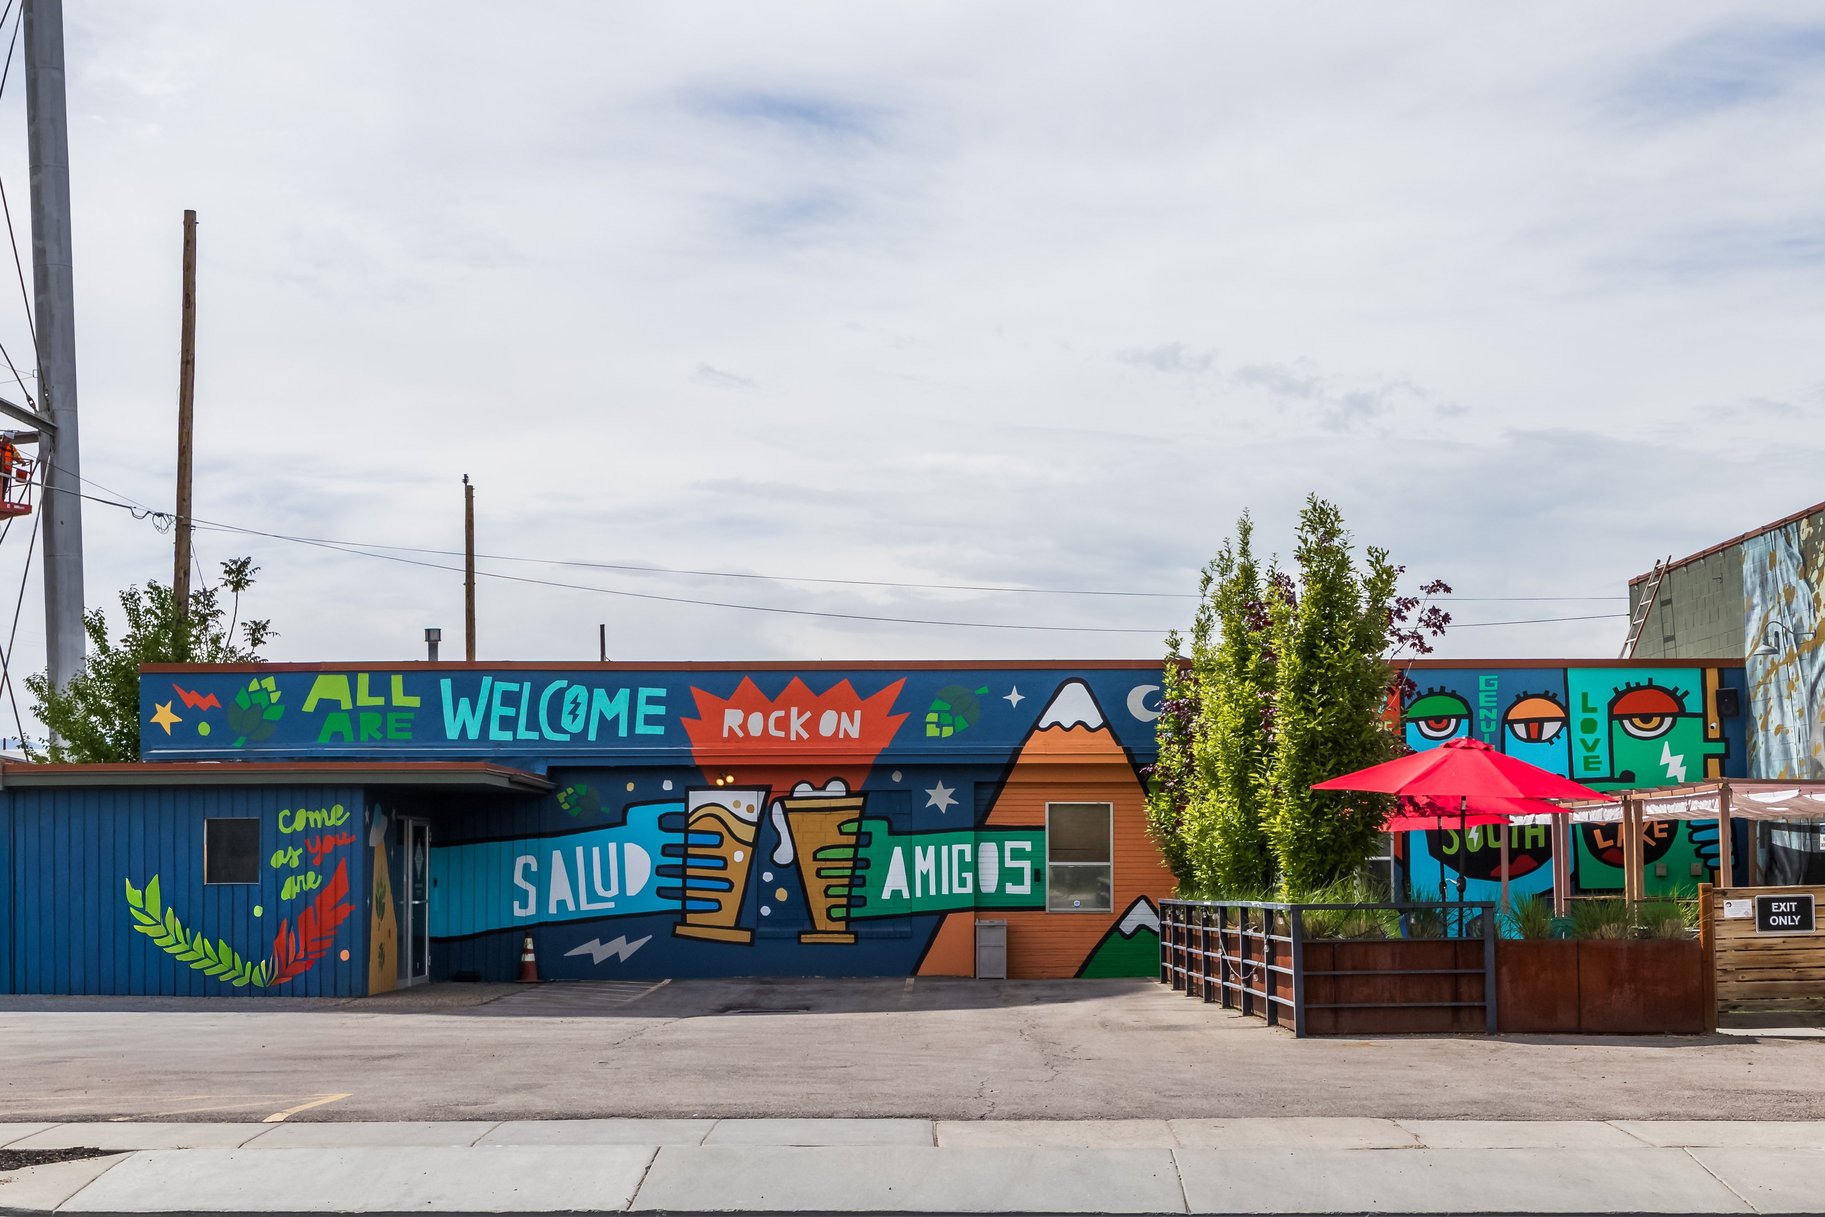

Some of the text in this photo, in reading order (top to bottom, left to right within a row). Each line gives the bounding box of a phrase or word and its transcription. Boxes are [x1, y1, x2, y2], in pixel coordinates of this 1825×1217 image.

[302, 673, 420, 712] ALL
[440, 676, 667, 741] WELCOME
[317, 712, 414, 744] ARE
[723, 707, 861, 741] ROCK ON
[1478, 675, 1498, 748] GENUI
[1579, 692, 1602, 771] LOVE
[270, 832, 356, 868] as you
[281, 871, 322, 900] are
[513, 842, 651, 917] SALUD
[881, 841, 1032, 899] AMIGOS
[1769, 915, 1801, 926] ONLY
[1771, 902, 1798, 912] EXIT
